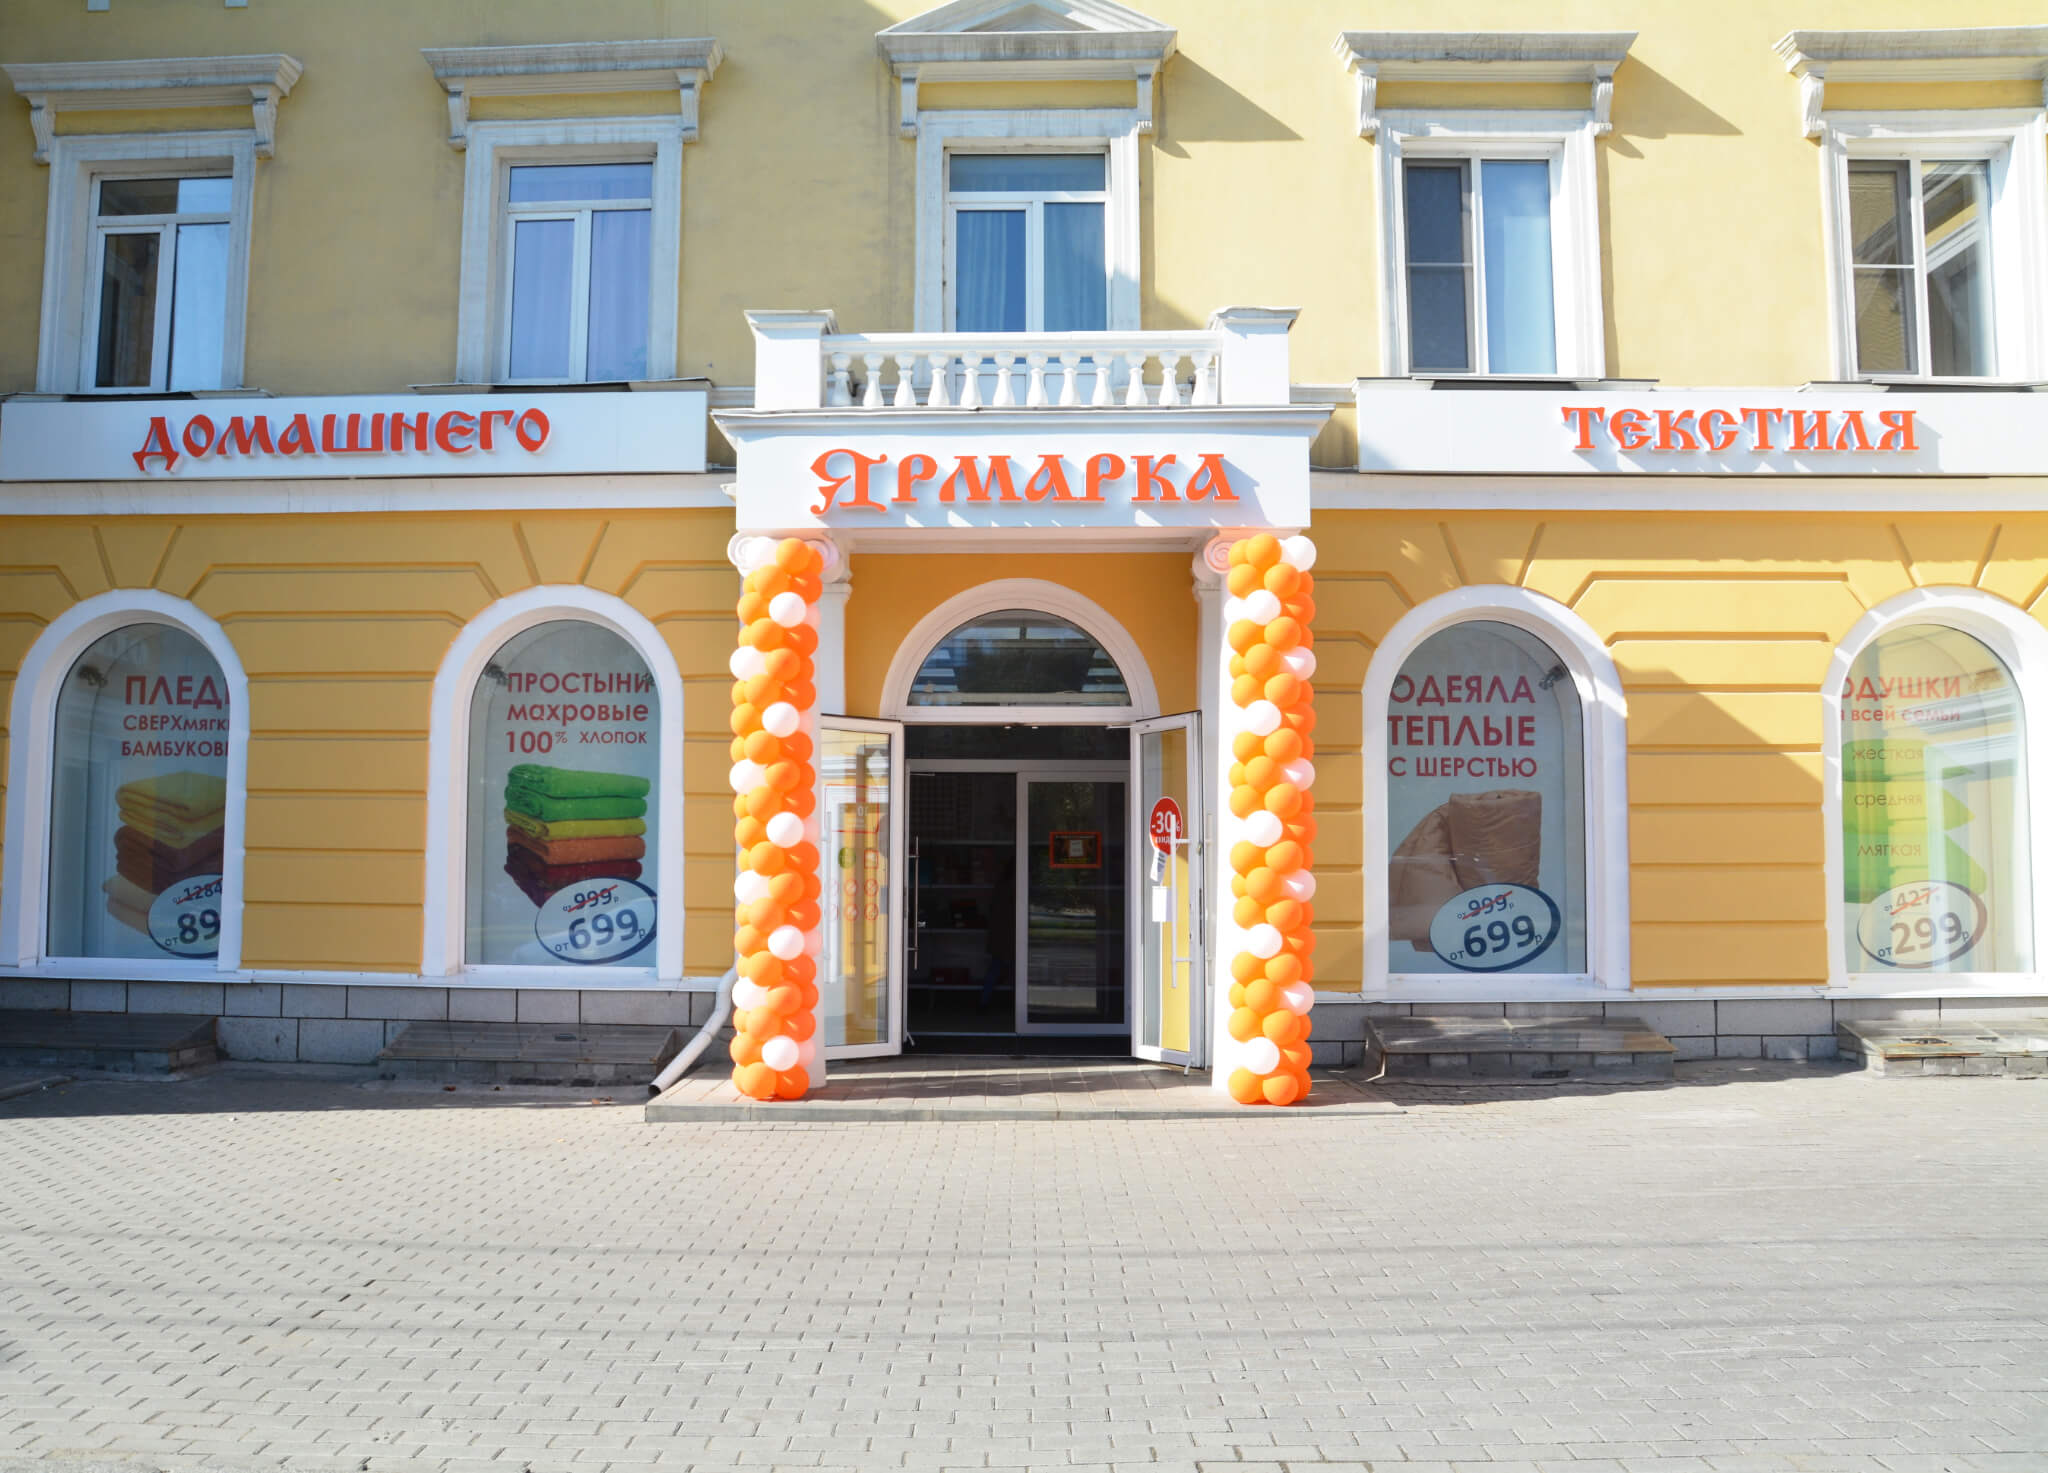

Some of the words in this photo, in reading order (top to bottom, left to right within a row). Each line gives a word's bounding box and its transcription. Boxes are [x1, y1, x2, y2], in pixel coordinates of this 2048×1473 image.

[1561, 407, 1919, 450] ТЕКСТИЛЯ
[132, 408, 550, 472] ДОМАШНЕГО
[810, 448, 1240, 515] ЯРМАРКА
[508, 672, 650, 693] ПРОСТЫНИ
[1390, 674, 1536, 706] ОДЕЯЛА
[507, 704, 648, 726] махровые
[1852, 706, 1895, 721] всей
[123, 714, 230, 731] СВЕРХмягк
[1388, 716, 1536, 746] ТЕПЛЫЕ
[579, 731, 647, 744] ХЛОПОК
[1853, 749, 1924, 760] жесткая
[1389, 757, 1407, 776] С
[1416, 757, 1537, 777] ШЕРСТЬЮ
[1854, 794, 1922, 808] средняя
[1857, 845, 1921, 856] мягкая
[555, 942, 569, 952] от
[1450, 950, 1465, 960] от
[1878, 946, 1892, 957] от
